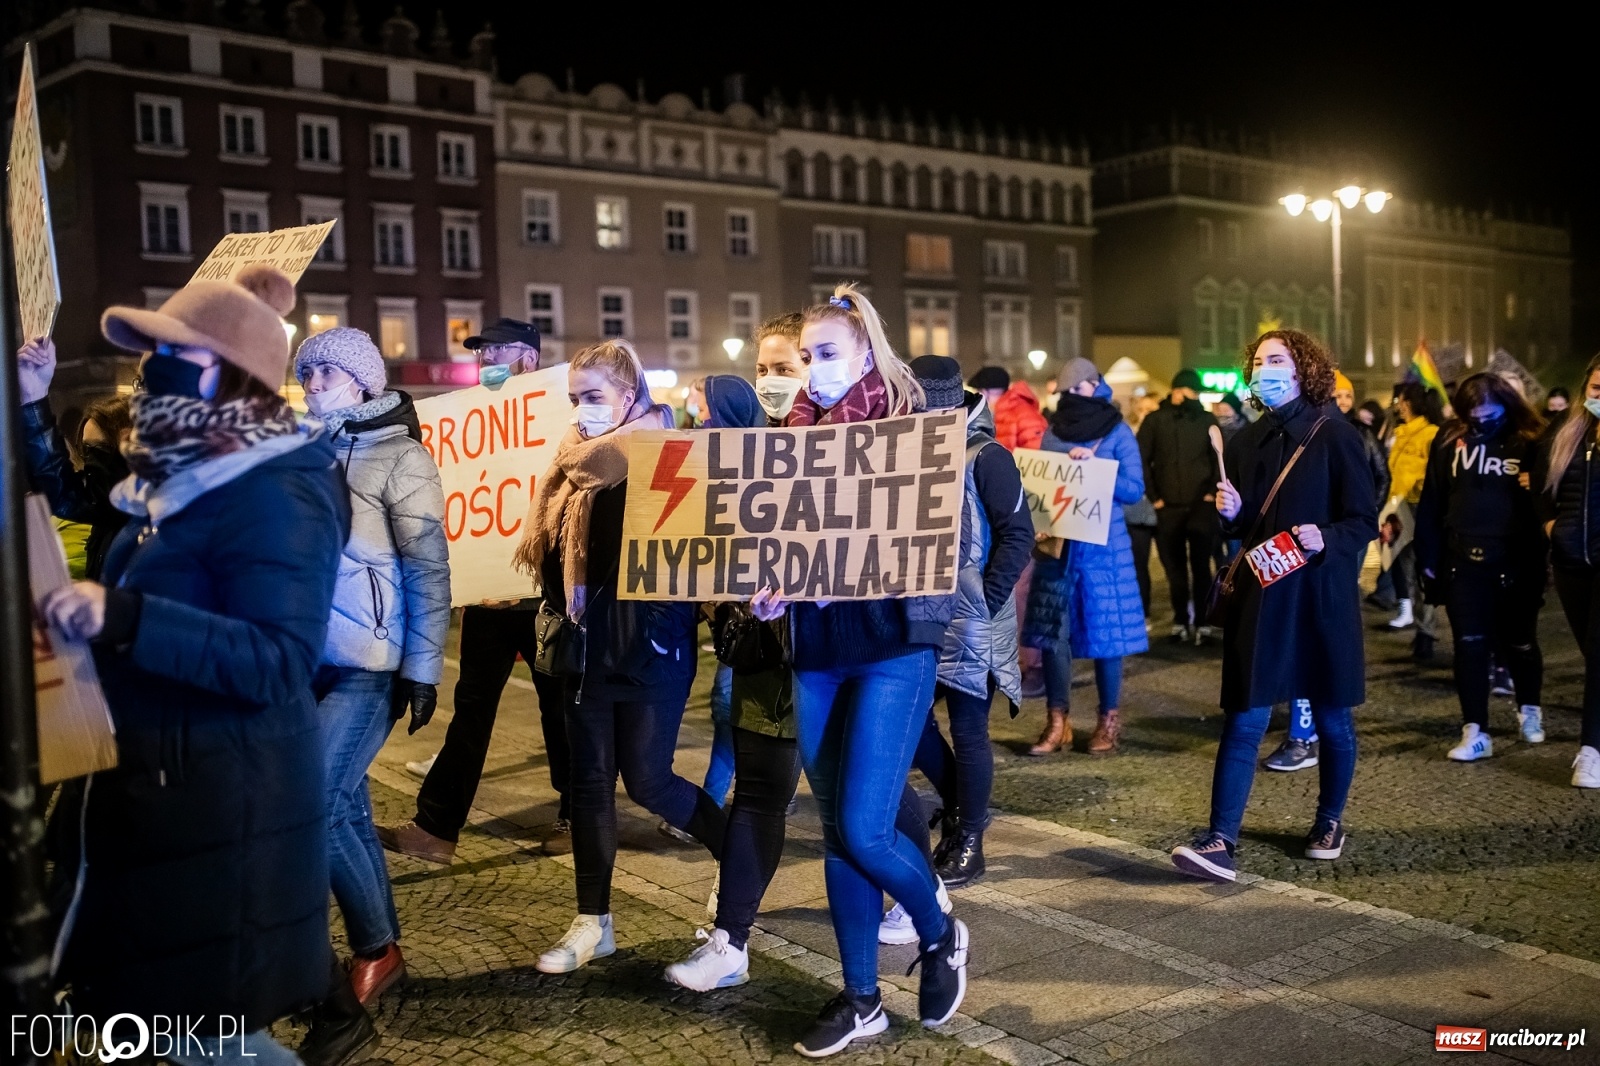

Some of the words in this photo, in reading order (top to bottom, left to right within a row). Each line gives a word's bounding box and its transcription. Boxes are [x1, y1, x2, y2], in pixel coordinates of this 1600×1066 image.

[261, 234, 286, 255] TO
[707, 411, 956, 480] LIBERTÉ
[1018, 456, 1085, 485] WOLNA
[626, 533, 955, 598] WYPIERDALAJTE
[1250, 540, 1281, 570] PIS
